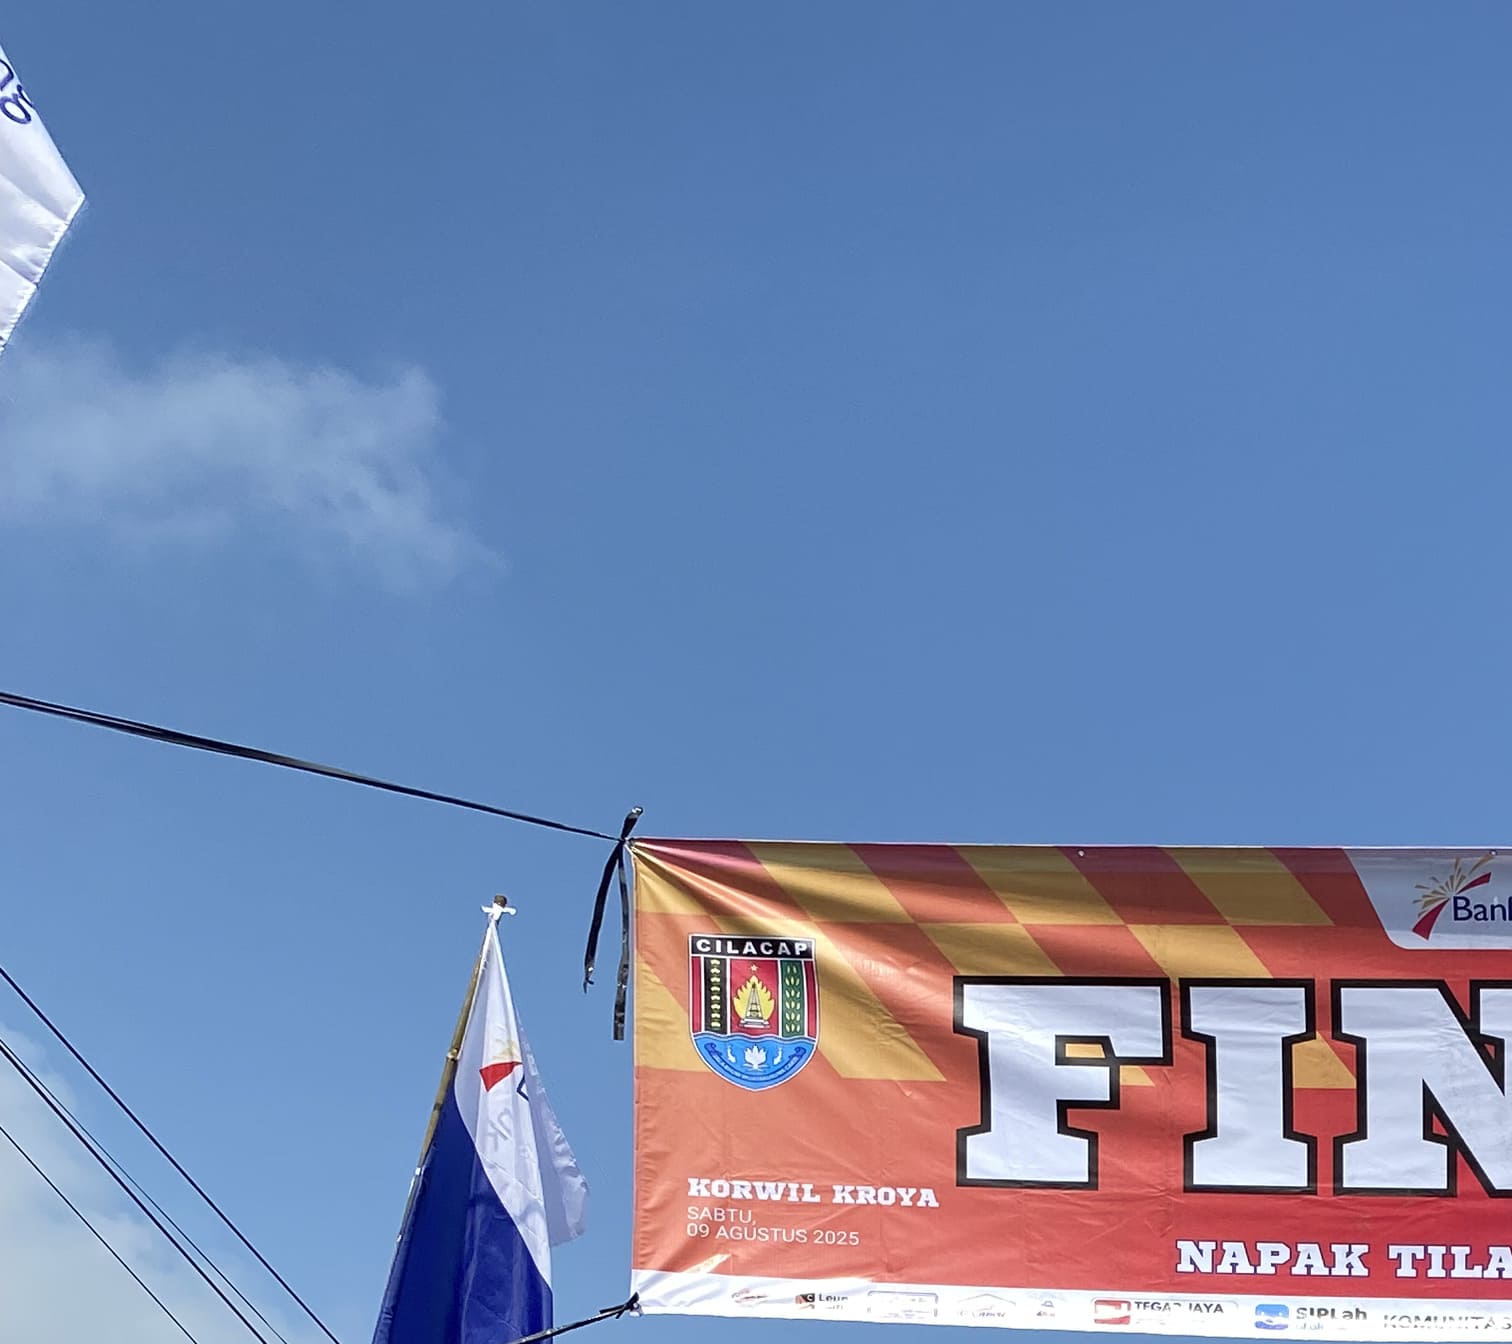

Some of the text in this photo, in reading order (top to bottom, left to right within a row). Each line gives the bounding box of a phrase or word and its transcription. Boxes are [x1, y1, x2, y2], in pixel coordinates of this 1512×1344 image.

[696, 939, 808, 956] CILACAP
[688, 1178, 939, 1208] KORWIL KROYA
[688, 1206, 757, 1226] SABTU,
[687, 1223, 860, 1246] 09 AGUSTUS 2025
[1174, 1239, 1371, 1278] NAPAK
